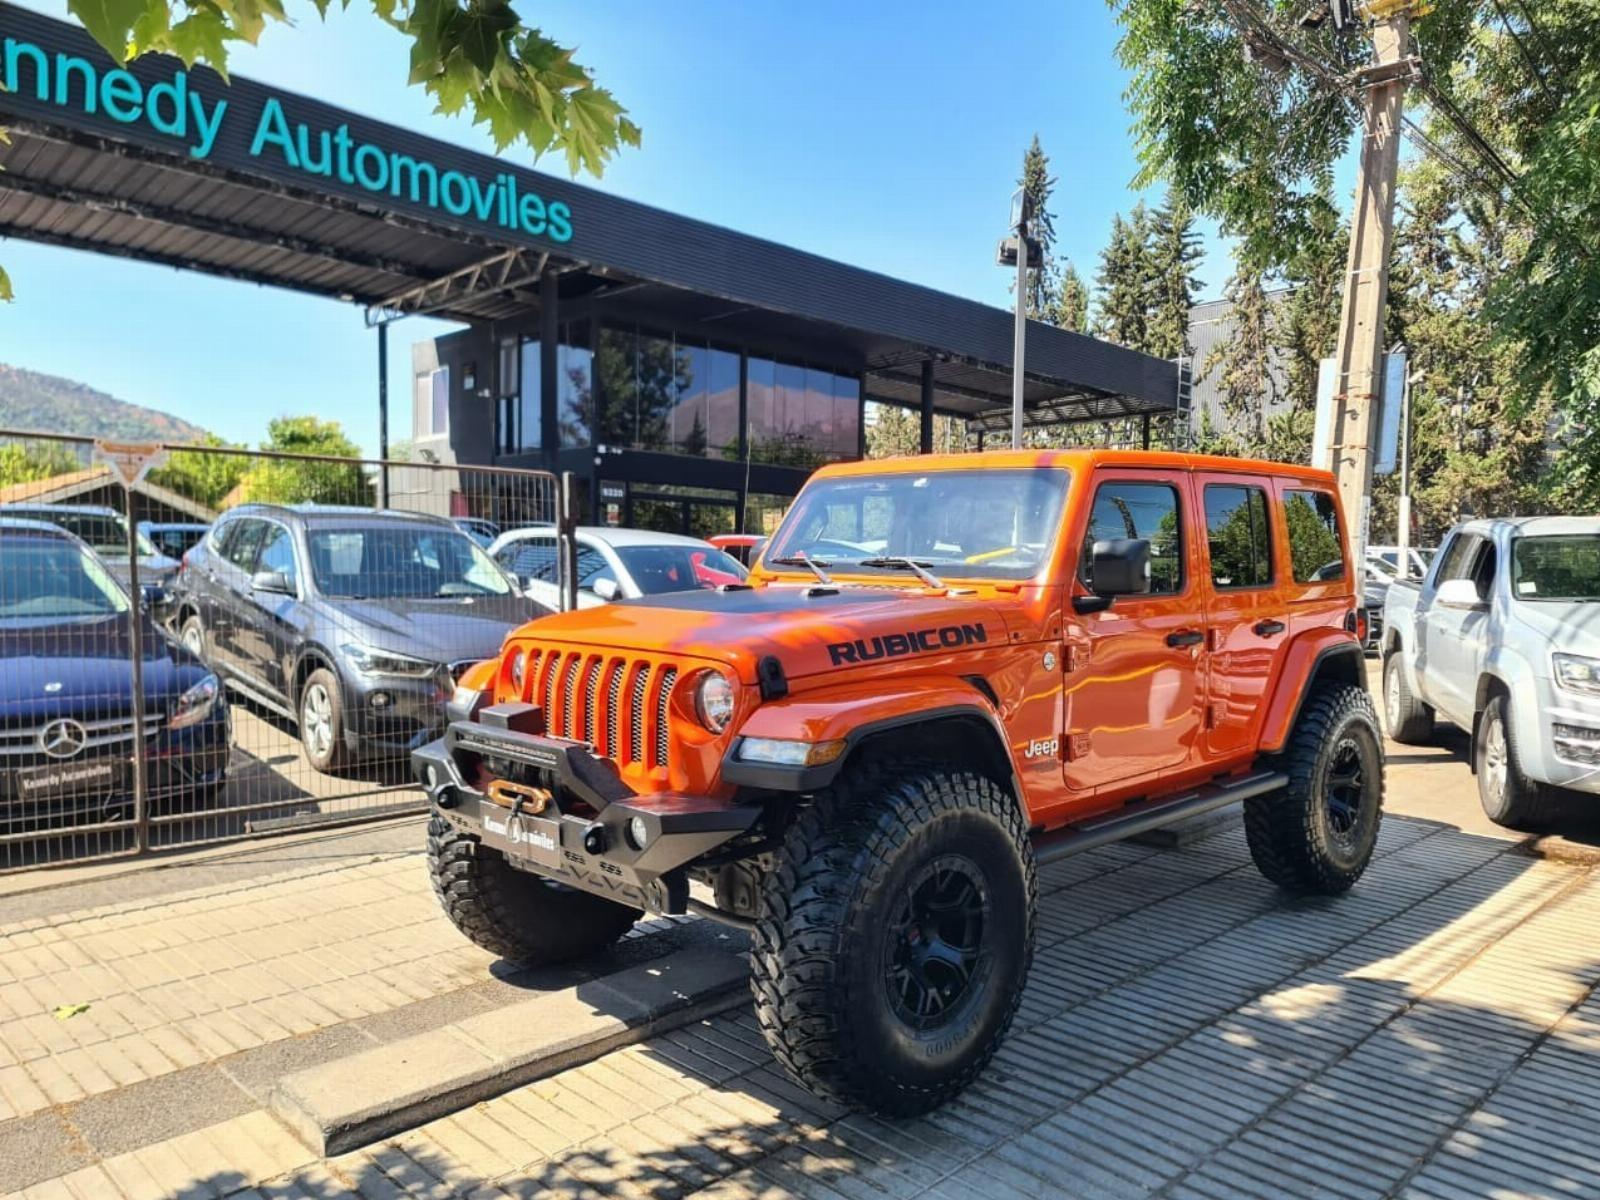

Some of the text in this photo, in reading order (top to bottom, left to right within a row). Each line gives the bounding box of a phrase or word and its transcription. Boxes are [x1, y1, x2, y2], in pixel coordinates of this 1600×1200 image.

[2, 37, 574, 243] nnedy Automoviles
[827, 623, 987, 666] RUBICON
[1024, 739, 1059, 759] Jeep
